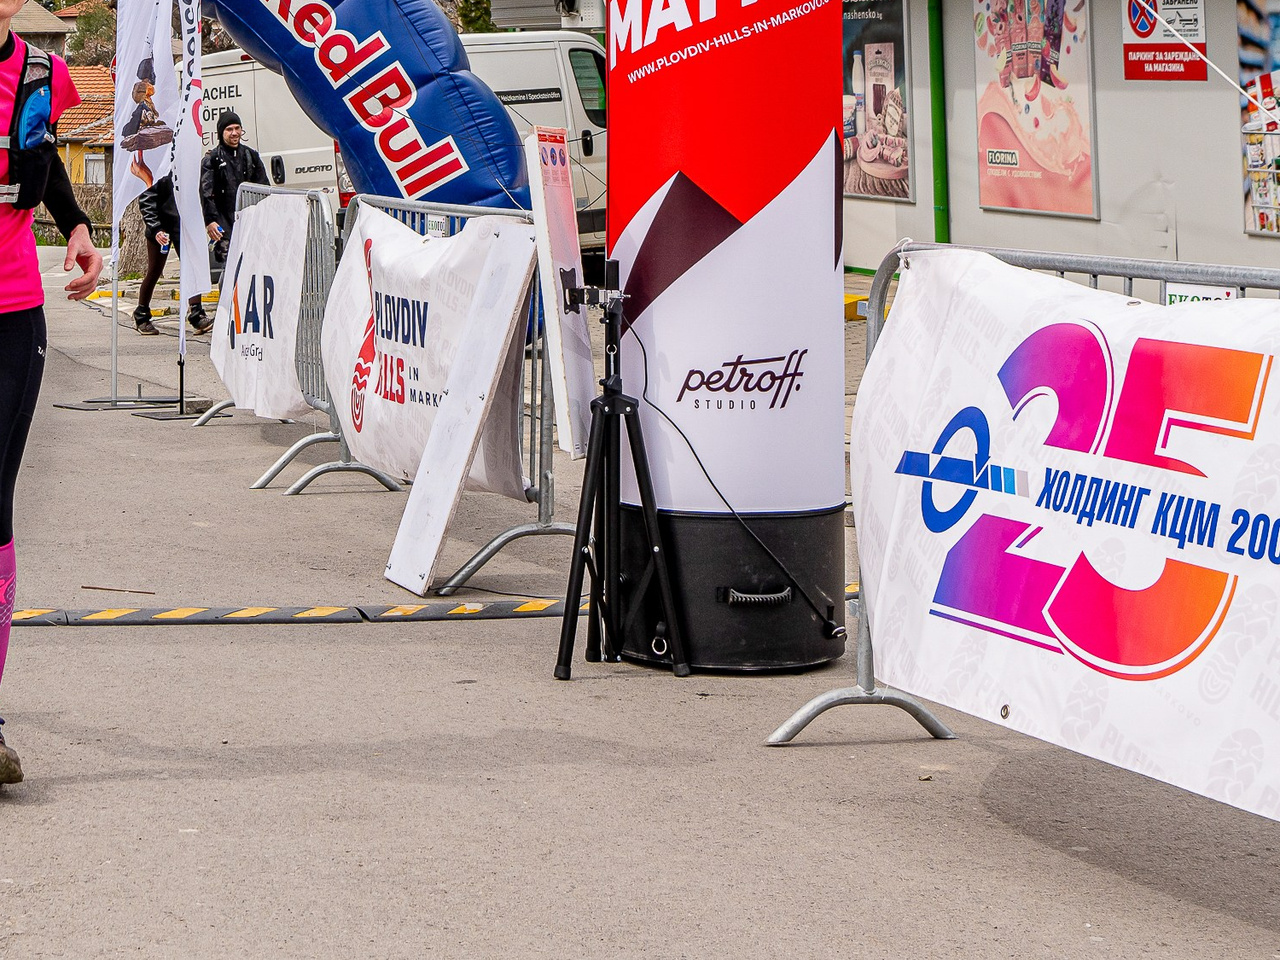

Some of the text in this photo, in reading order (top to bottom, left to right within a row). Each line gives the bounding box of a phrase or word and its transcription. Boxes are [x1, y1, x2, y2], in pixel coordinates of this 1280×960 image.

[1128, 51, 1154, 61] ПАРКИНГ
[1155, 51, 1163, 61] ЗА
[1144, 63, 1185, 72] НА МАГАЗИНА
[346, 62, 468, 199] Bull
[987, 150, 1018, 166] FLORINA
[295, 164, 333, 174] DUCATO
[374, 291, 429, 348] PLOVDIV
[408, 365, 419, 381] IN
[409, 387, 442, 408] MARK
[694, 399, 756, 410] STUDIO
[1036, 467, 1153, 527] ХОЛДИНГ
[1151, 491, 1221, 551] КЦМ
